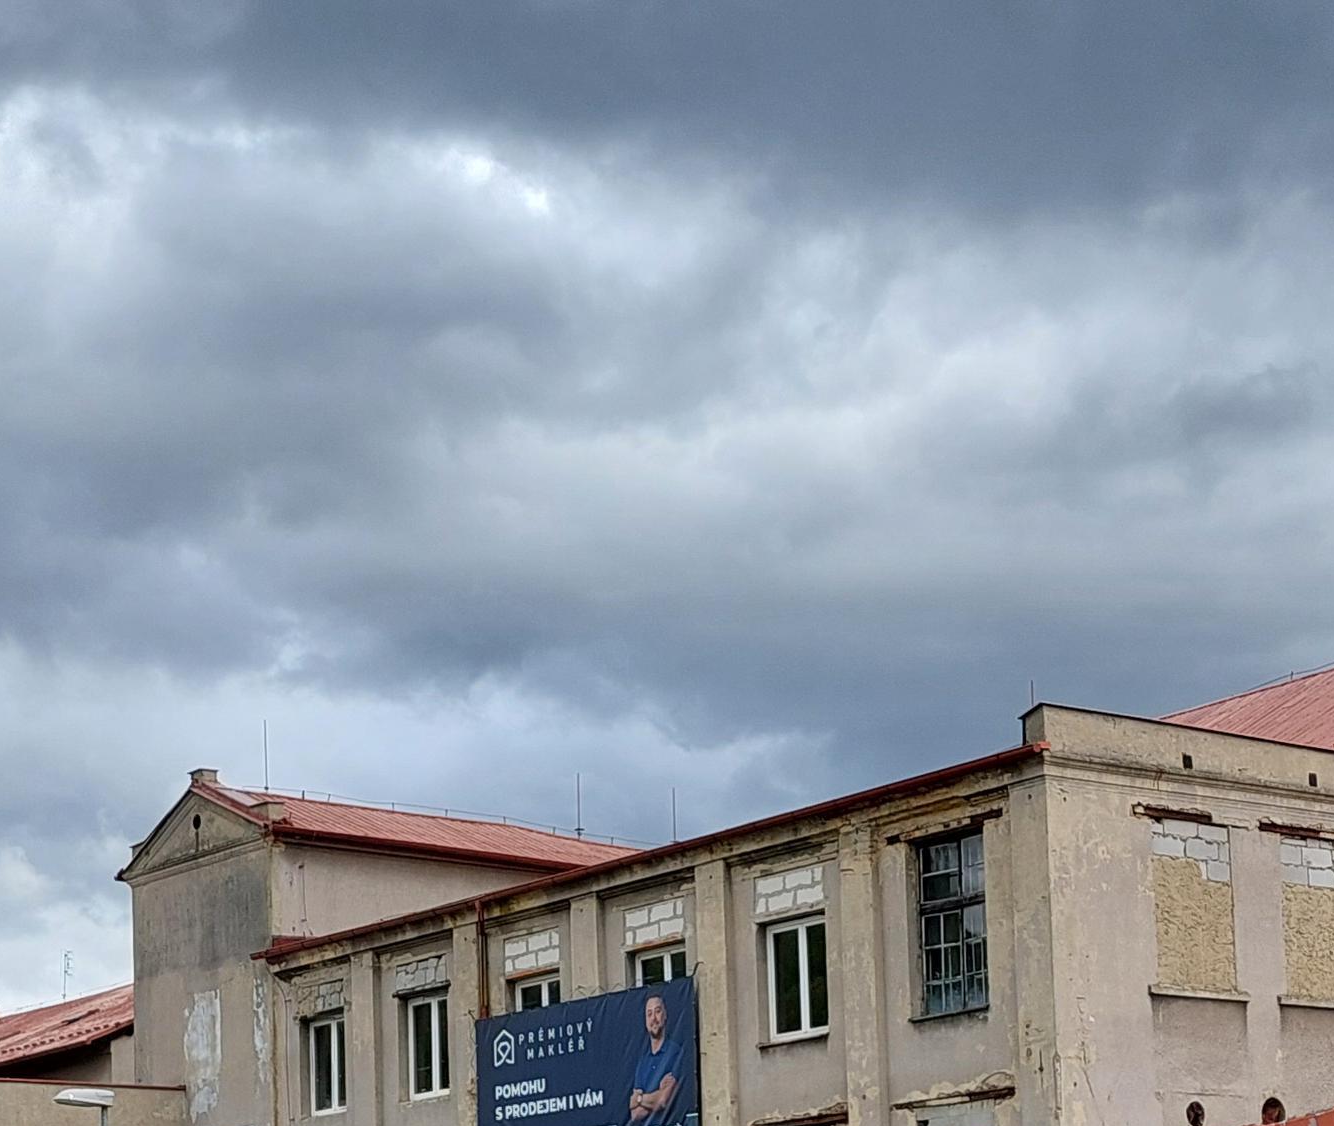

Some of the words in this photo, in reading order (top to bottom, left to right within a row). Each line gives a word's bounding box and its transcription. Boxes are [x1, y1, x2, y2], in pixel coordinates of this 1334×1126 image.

[518, 1017, 593, 1046] PRÉMIOVÝ
[527, 1035, 585, 1061] MAKLÉŘ
[495, 1078, 546, 1101] POMOHU
[495, 1106, 503, 1121] S
[505, 1096, 567, 1120] PRODEJEM
[569, 1095, 574, 1110] I
[575, 1088, 604, 1109] VÁM
